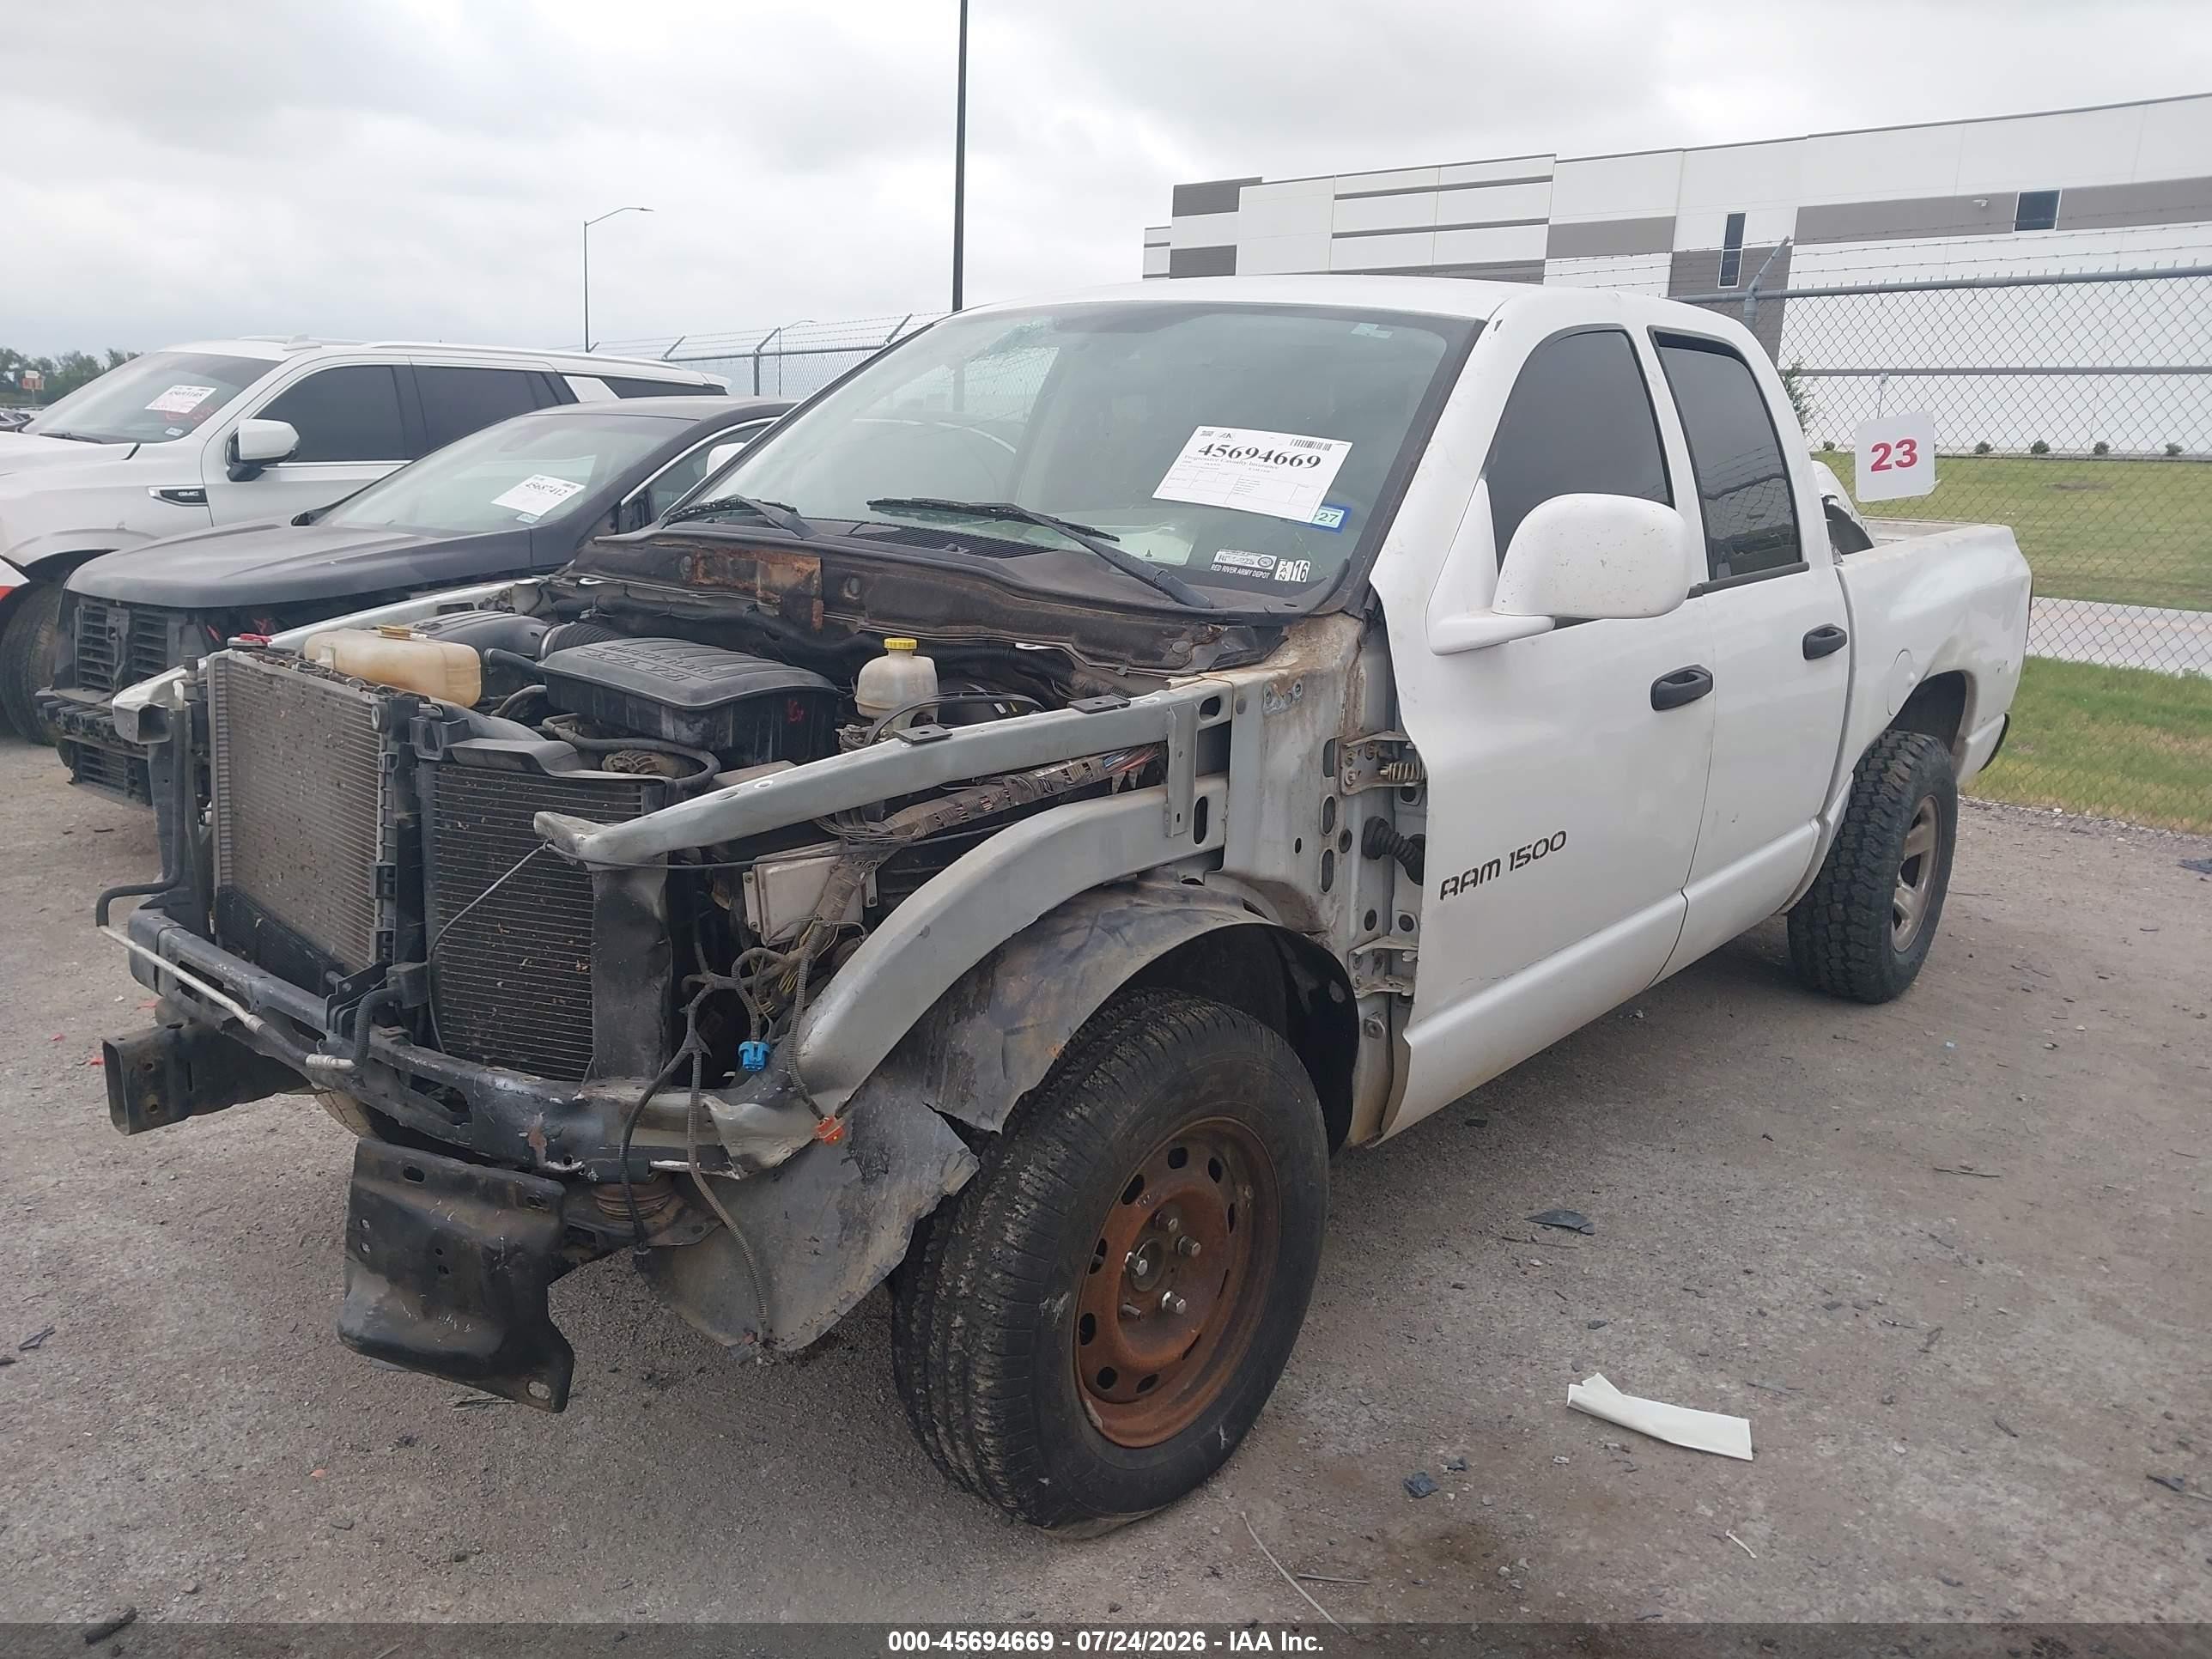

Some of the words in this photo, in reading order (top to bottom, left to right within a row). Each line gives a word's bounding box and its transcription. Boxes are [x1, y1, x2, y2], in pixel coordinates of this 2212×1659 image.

[1198, 443, 1322, 469] 45694669
[1871, 439, 1918, 471] 23
[1318, 513, 1339, 522] 27
[1222, 565, 1237, 574] RIVER
[1237, 567, 1252, 575] ARMY
[1251, 570, 1271, 579] DEPOT
[1279, 562, 1288, 580] JAN
[1294, 562, 1308, 581] 16
[1440, 858, 1501, 901] RAM
[1510, 830, 1566, 872] 1500
